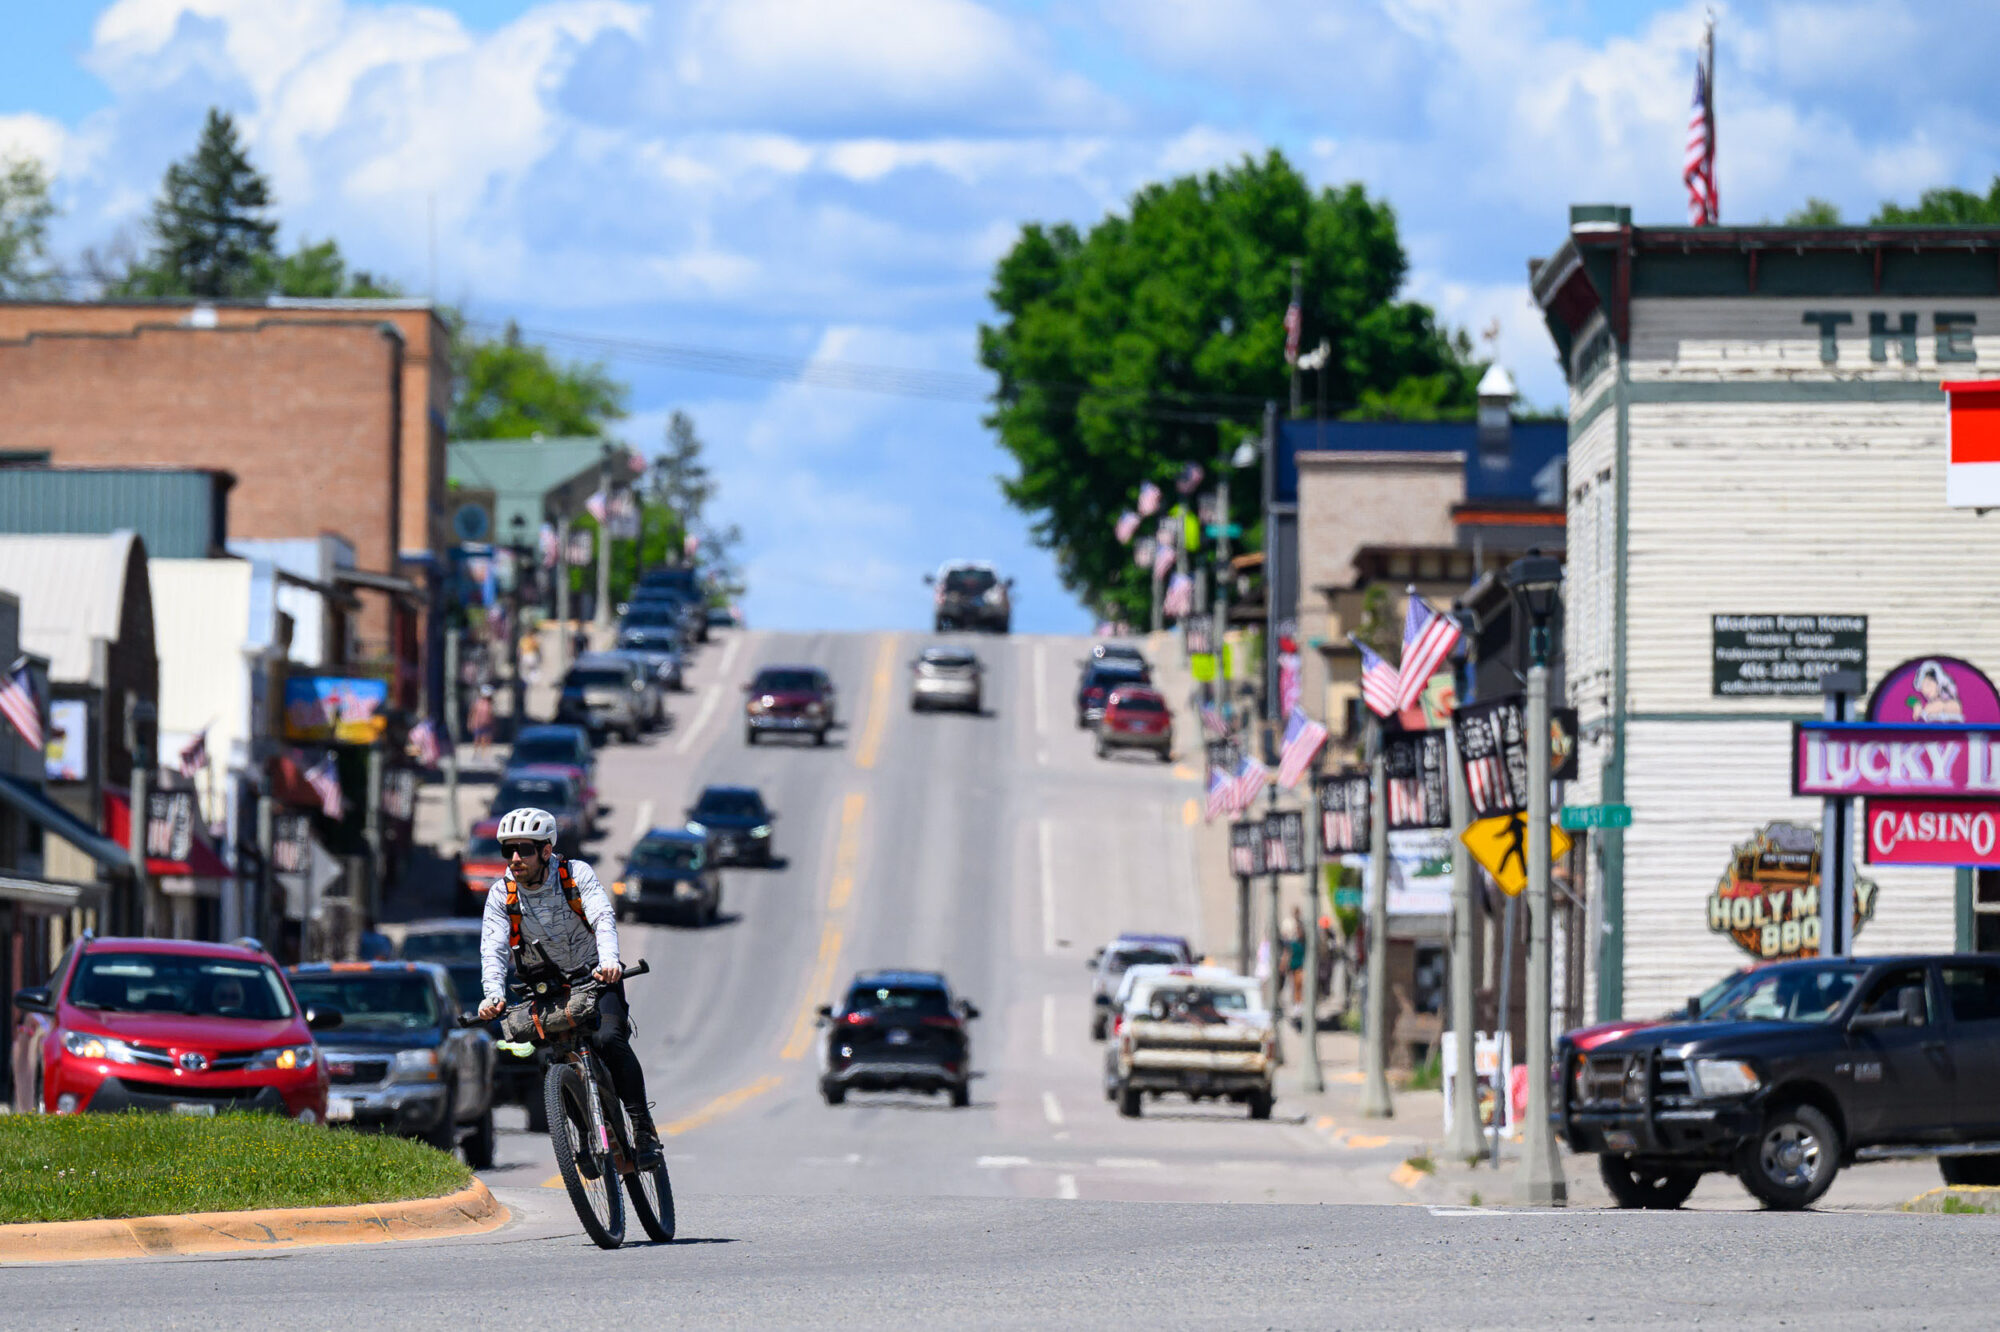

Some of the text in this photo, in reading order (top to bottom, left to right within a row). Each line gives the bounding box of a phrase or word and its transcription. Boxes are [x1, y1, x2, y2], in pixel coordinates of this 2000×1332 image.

[1802, 311, 1977, 363] THE
[1715, 616, 1864, 632] Modern Farm Home
[1804, 731, 1960, 788] LUCKY
[1873, 810, 1996, 857] CASINO
[1711, 884, 1874, 930] HOLY MY
[1760, 915, 1821, 959] BBQ
